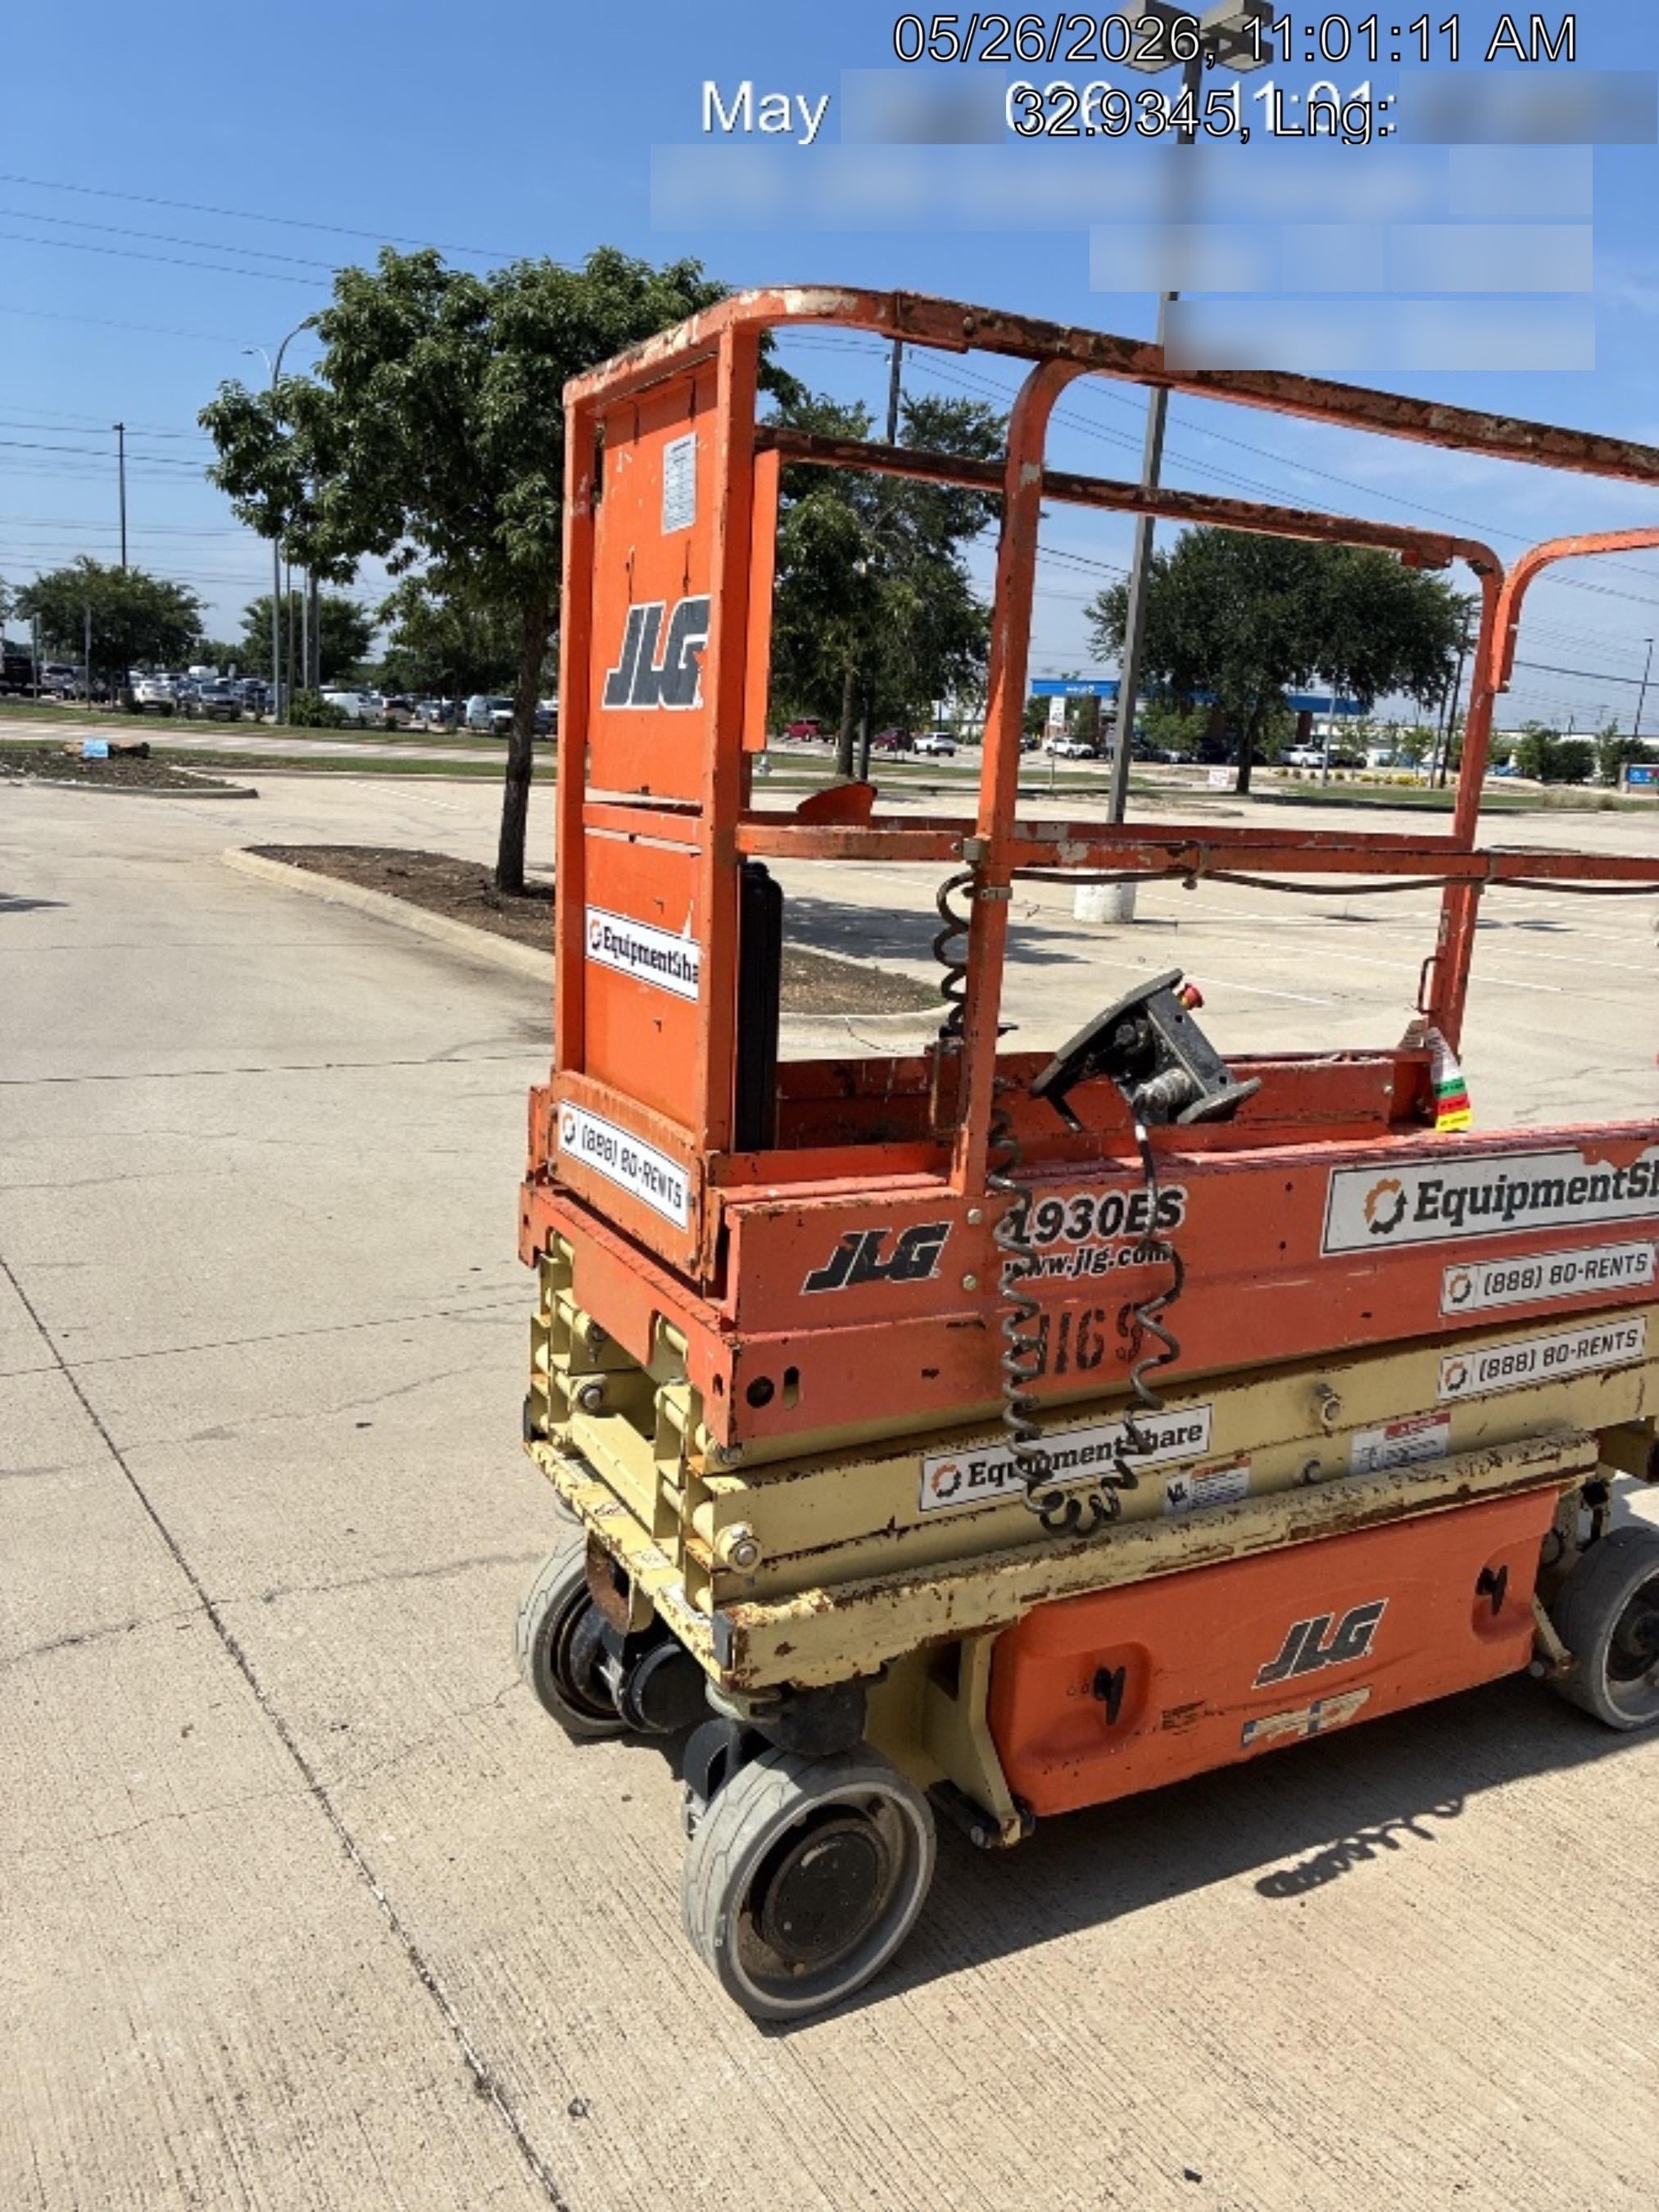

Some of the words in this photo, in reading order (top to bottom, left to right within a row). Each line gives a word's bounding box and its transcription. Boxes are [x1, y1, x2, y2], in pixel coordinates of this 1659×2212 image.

[601, 595, 712, 710] JLG
[800, 1222, 953, 1296] JLG
[1483, 1265, 1543, 1297] (888)
[1478, 1348, 1536, 1383] (888)
[1250, 1597, 1389, 1690] JLG
